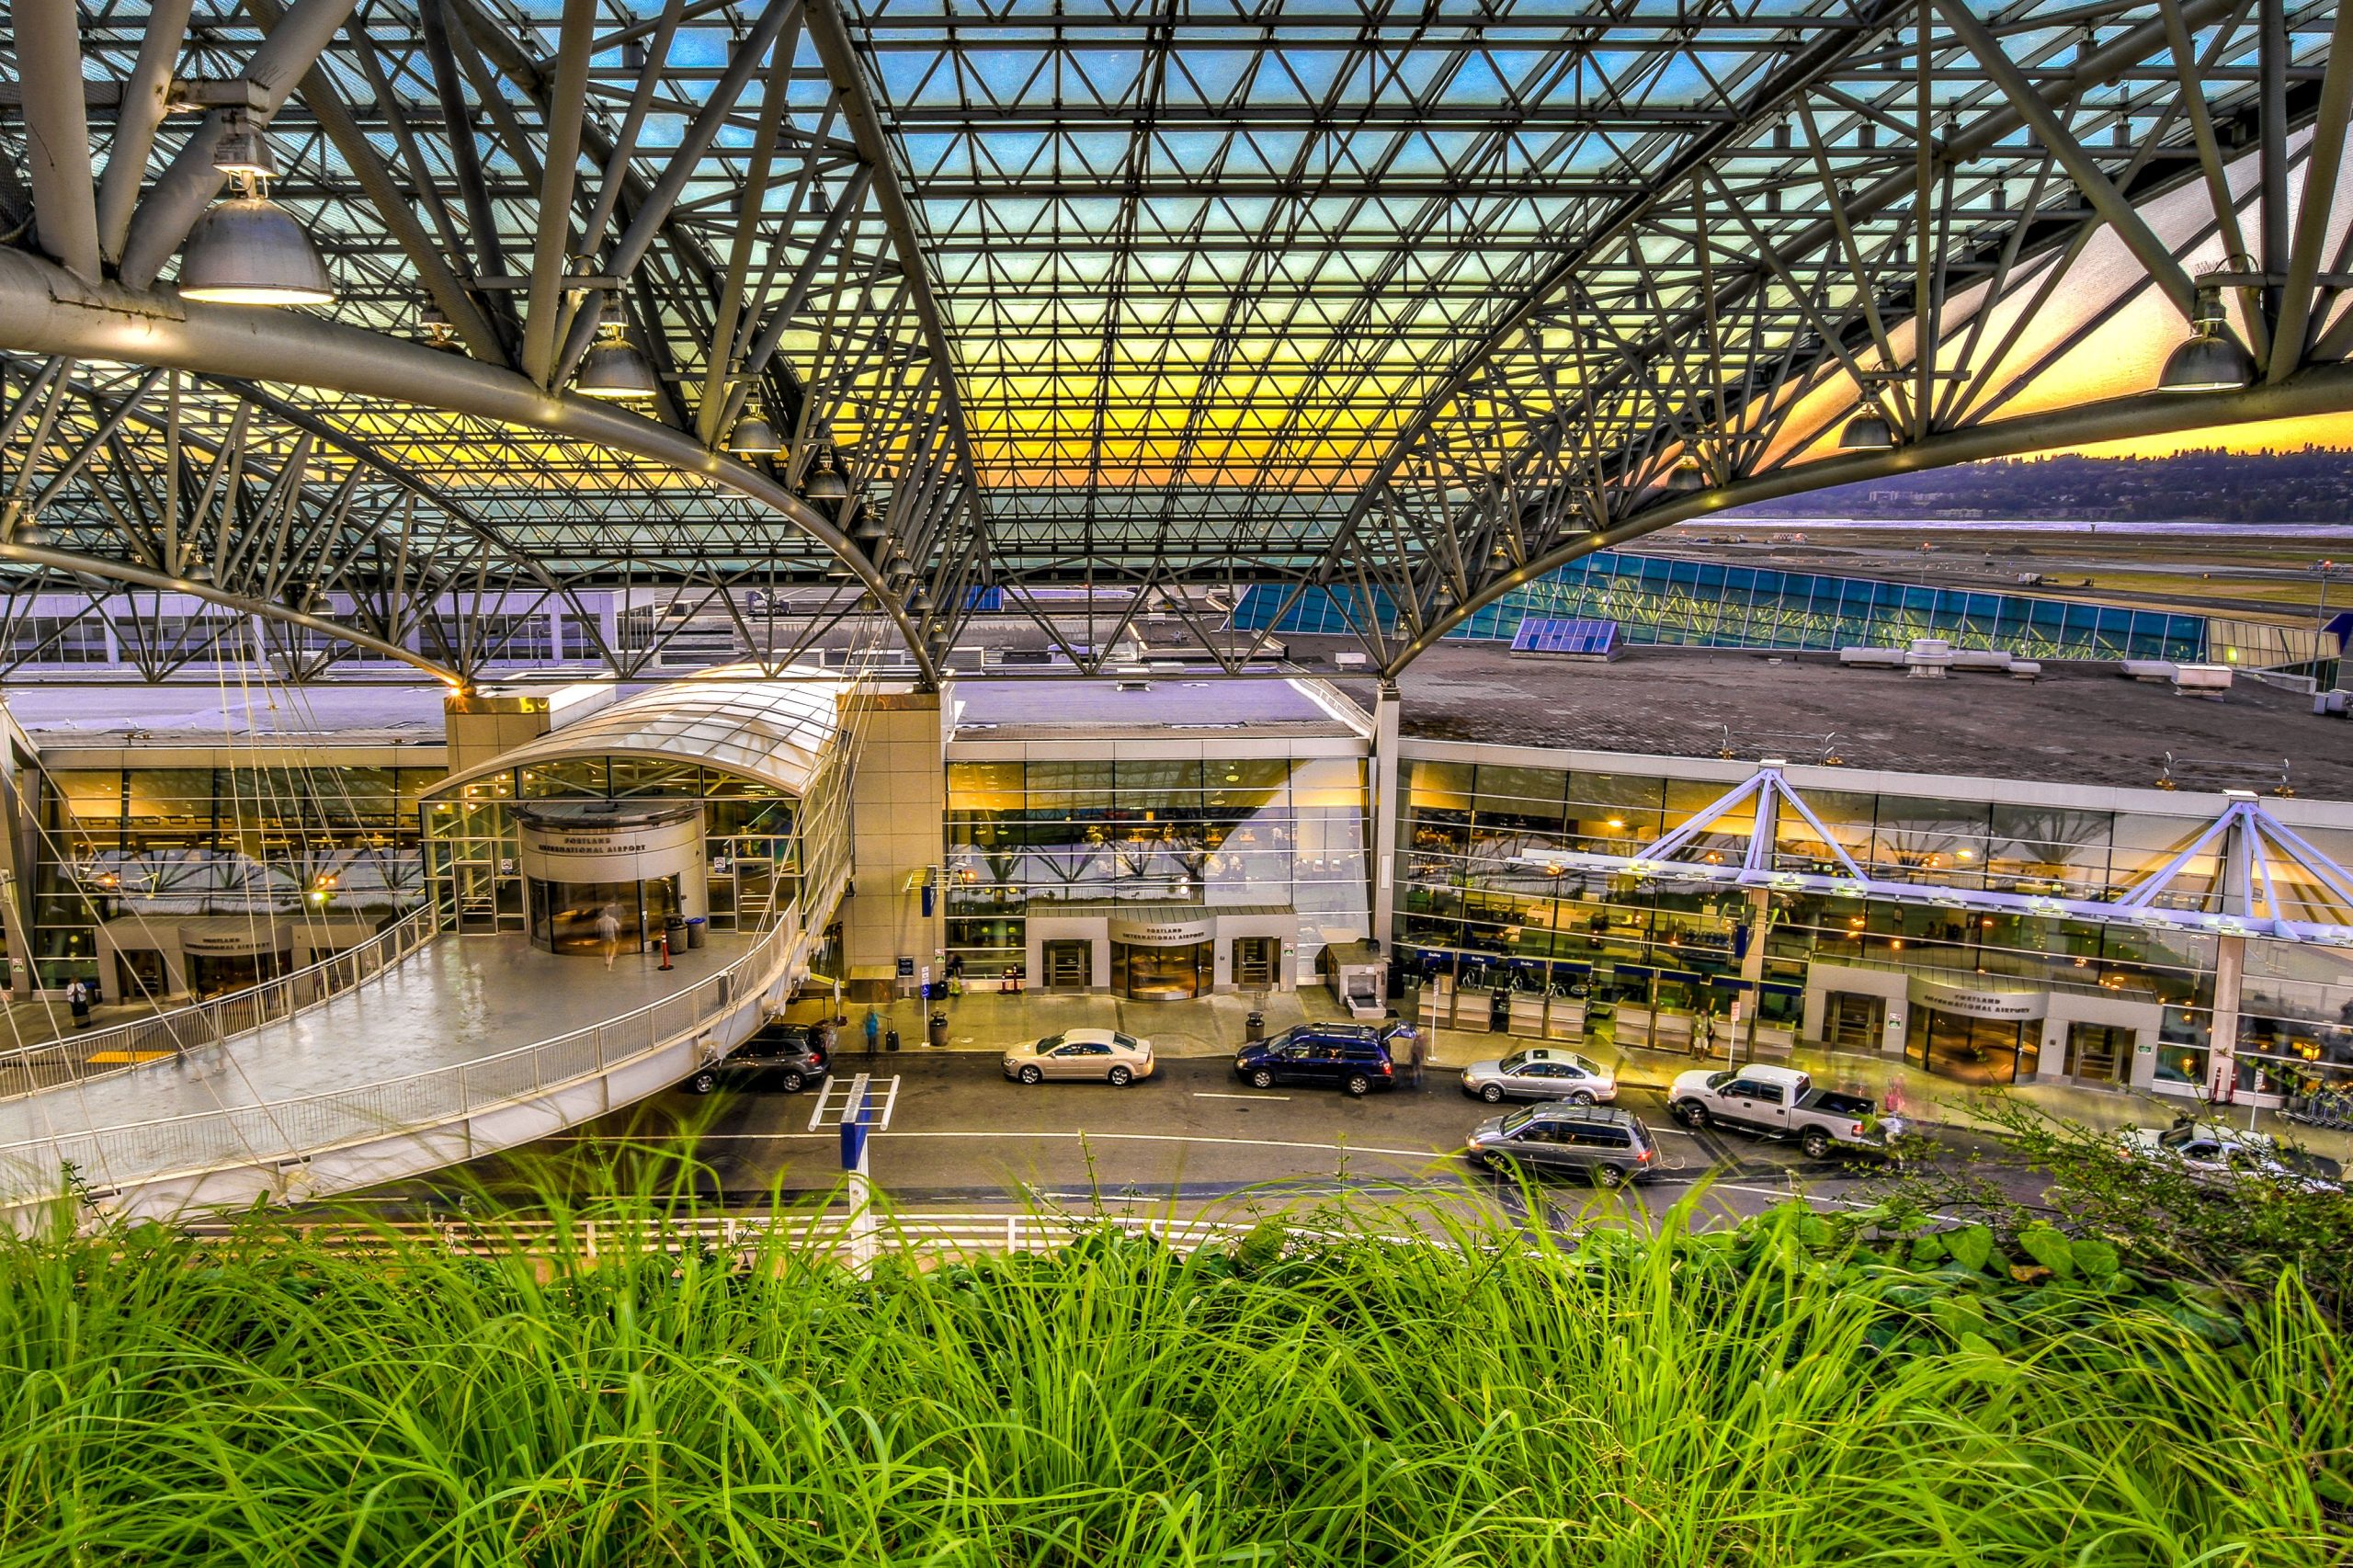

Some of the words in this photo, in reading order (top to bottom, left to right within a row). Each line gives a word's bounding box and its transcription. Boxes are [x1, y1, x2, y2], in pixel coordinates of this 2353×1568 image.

[608, 845, 646, 853] AIRPORT
[1924, 994, 1992, 1012] INTERNATIONAL
[1954, 994, 2001, 1005] PORTLAND
